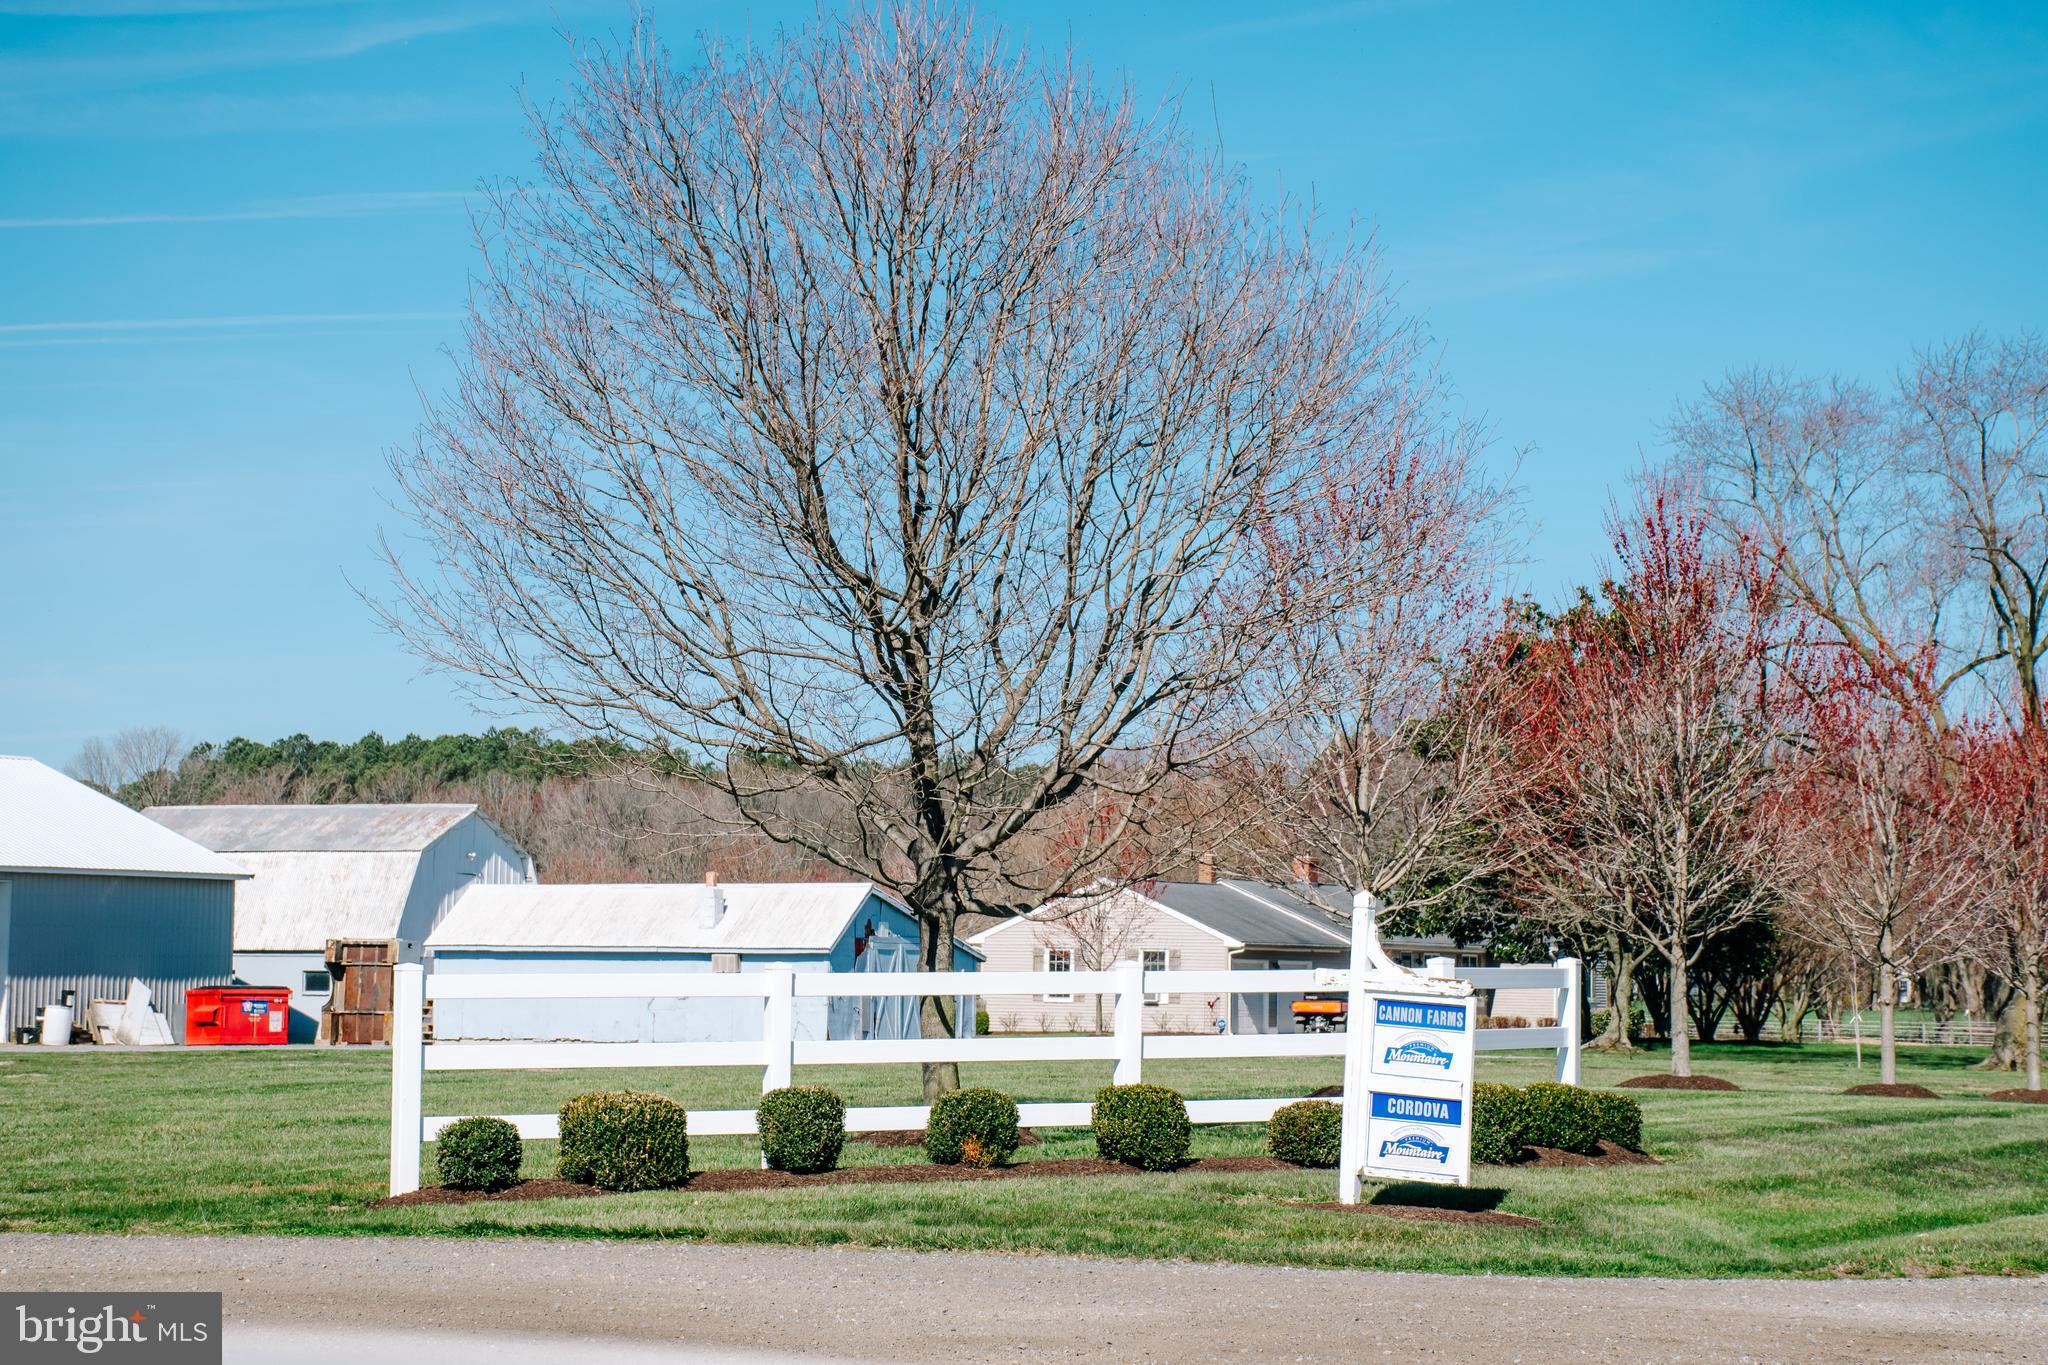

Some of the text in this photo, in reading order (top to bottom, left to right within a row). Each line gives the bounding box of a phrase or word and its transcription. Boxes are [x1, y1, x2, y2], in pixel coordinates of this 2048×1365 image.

[1378, 1005, 1464, 1027] CANNON FARMS
[1388, 1048, 1449, 1065] Mountaire
[1387, 1097, 1449, 1119] CORDOVA
[1404, 1136, 1431, 1145] PREMIUM
[1383, 1142, 1445, 1160] Mountaire
